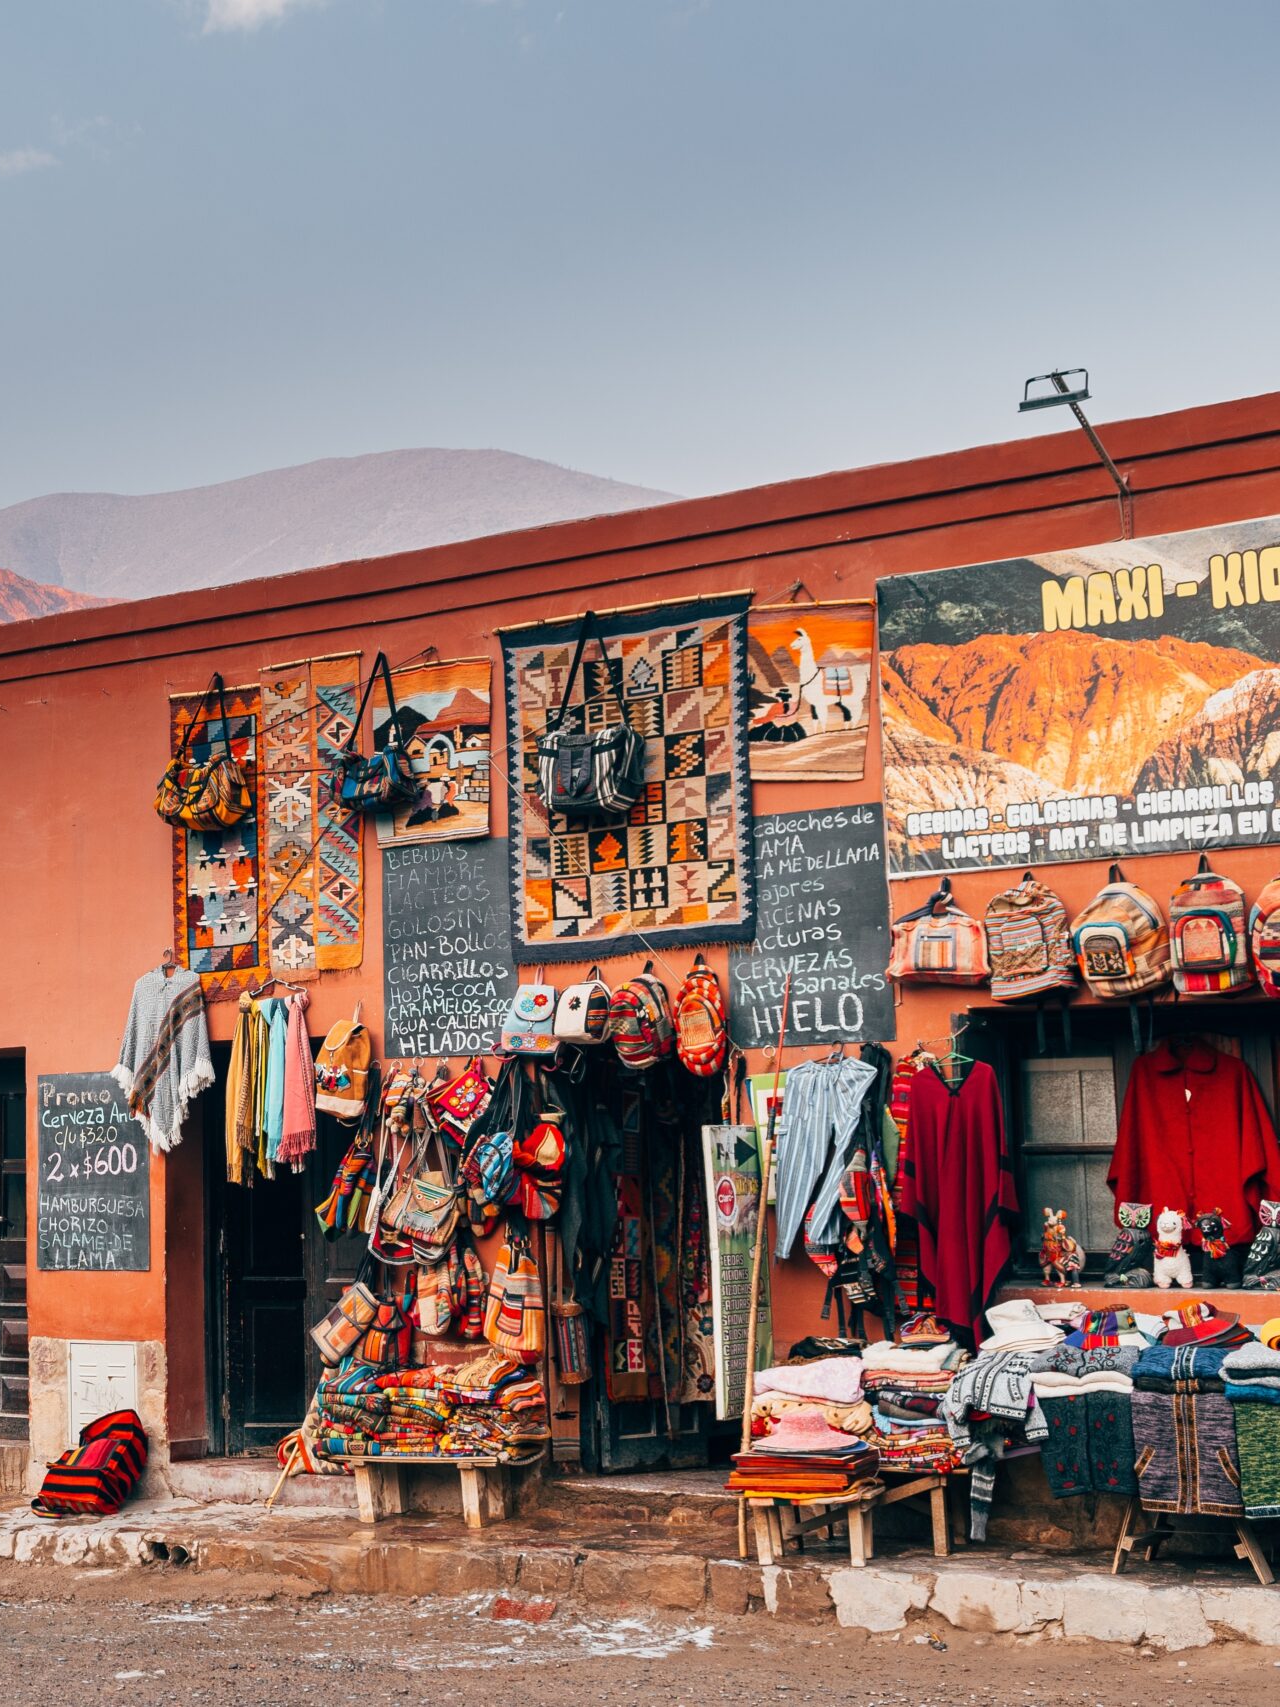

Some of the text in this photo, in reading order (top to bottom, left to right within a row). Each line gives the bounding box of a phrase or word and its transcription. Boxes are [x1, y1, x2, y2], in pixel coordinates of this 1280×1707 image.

[1041, 563, 1164, 632] MAXI
[753, 807, 875, 838] cabeches de
[907, 807, 989, 836] BEBIDAS
[1006, 795, 1118, 828] GOLOSINAS
[1136, 780, 1274, 815] CIGARRILLOS
[941, 831, 1031, 860] LACTEOS
[1049, 826, 1095, 851] ART.
[1099, 822, 1127, 847] DE
[1131, 813, 1233, 844] LIMPIEZA
[1238, 810, 1267, 835] EN
[386, 844, 468, 870] BEBIDAS
[386, 859, 486, 893] FIAMBRE
[388, 880, 490, 915] LACTEOS
[757, 877, 825, 908] ajores
[388, 959, 509, 985] CIGARRILLOS
[734, 948, 853, 981] CERVEZAS
[390, 980, 496, 1006] HOJAS-COCA
[740, 968, 885, 1006] Artesanales
[752, 992, 864, 1038] HIELO
[399, 1031, 496, 1056] HELADOS
[39, 1083, 112, 1107] Promo
[41, 1107, 105, 1128] Cerveza
[79, 1126, 118, 1149] $320
[47, 1143, 138, 1182] 2 x $600
[39, 1194, 145, 1218] HAMBURGUESA
[38, 1216, 109, 1234] CHORIZO
[54, 1249, 117, 1270] LLAMA
